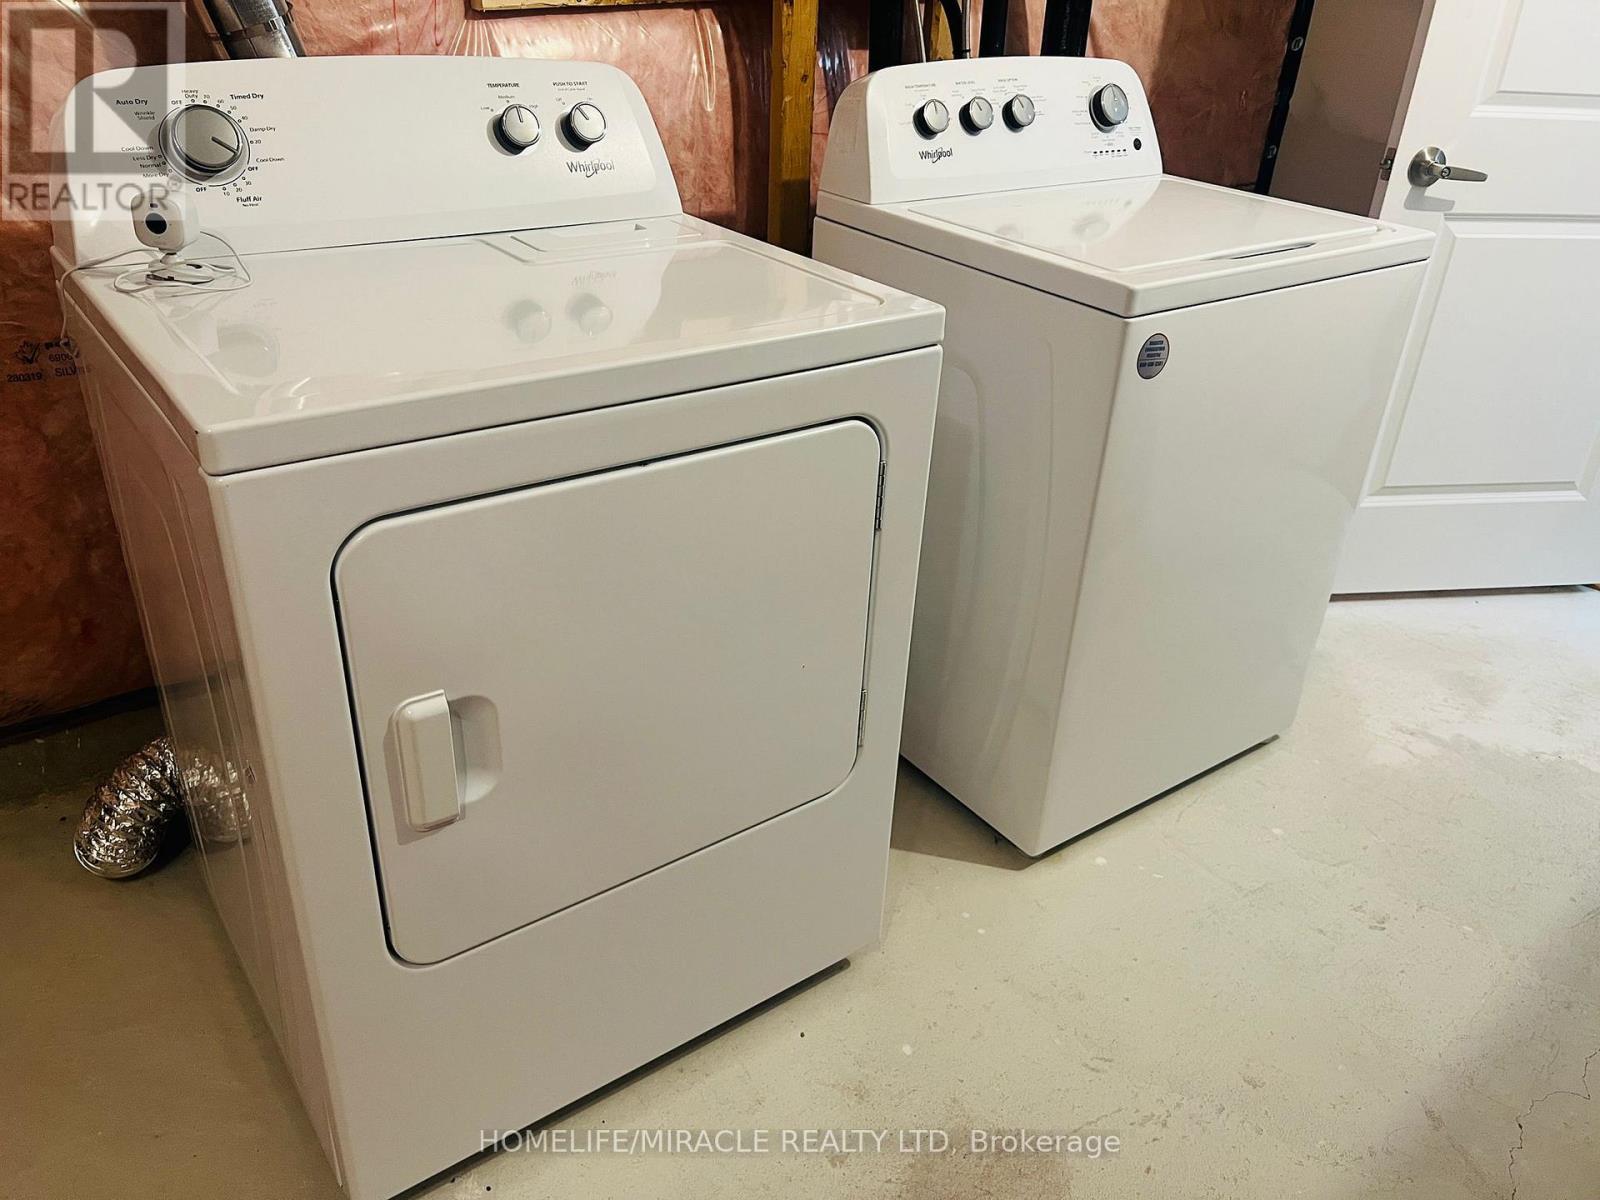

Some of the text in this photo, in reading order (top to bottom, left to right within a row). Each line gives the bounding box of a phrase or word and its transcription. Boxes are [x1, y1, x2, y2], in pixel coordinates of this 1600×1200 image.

[251, 92, 264, 100] Dry
[919, 147, 953, 163] Whirlpool
[566, 159, 615, 178] Whirlpool
[7, 371, 43, 383] 280319
